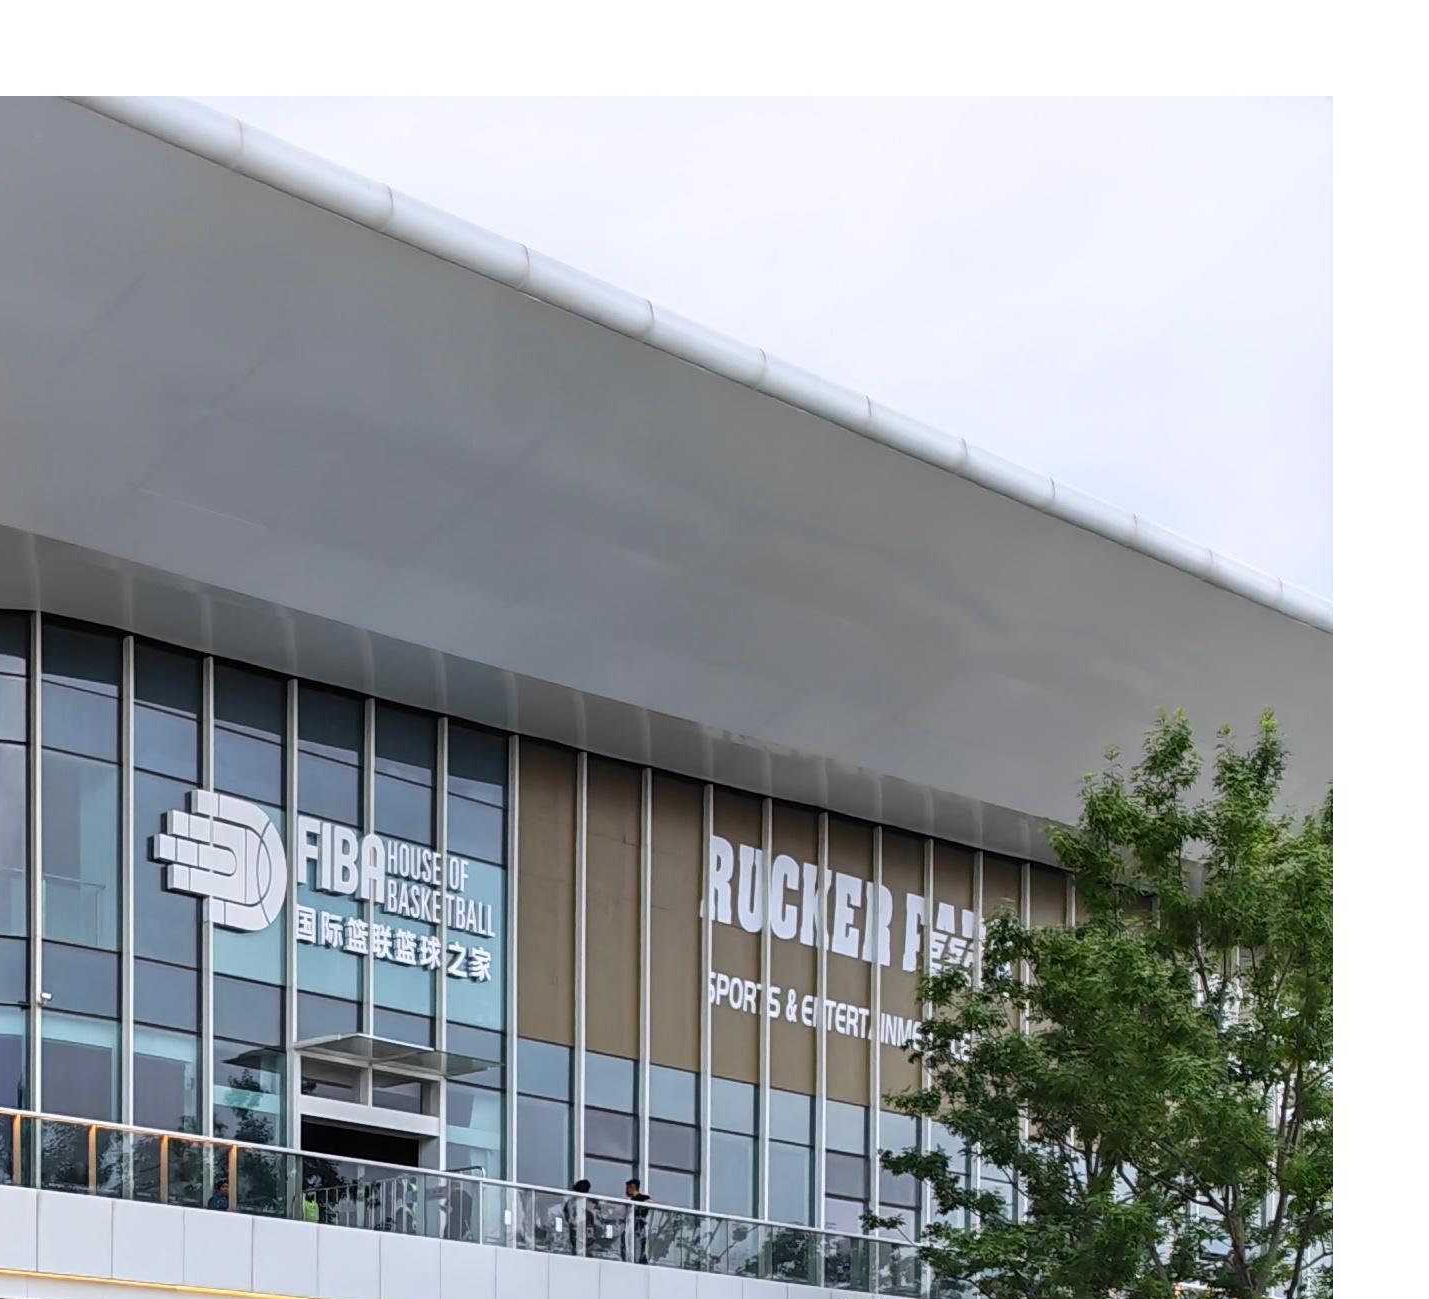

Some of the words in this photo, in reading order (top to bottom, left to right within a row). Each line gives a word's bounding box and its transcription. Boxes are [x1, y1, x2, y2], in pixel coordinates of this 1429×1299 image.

[297, 813, 385, 903] FIBA
[386, 840, 442, 886] HOUSE
[449, 858, 470, 893] OF
[385, 878, 496, 938] BASKETBALL
[700, 834, 893, 967] RUCKER
[296, 904, 493, 982] 国际篮联篮球之家
[785, 989, 798, 1024] &
